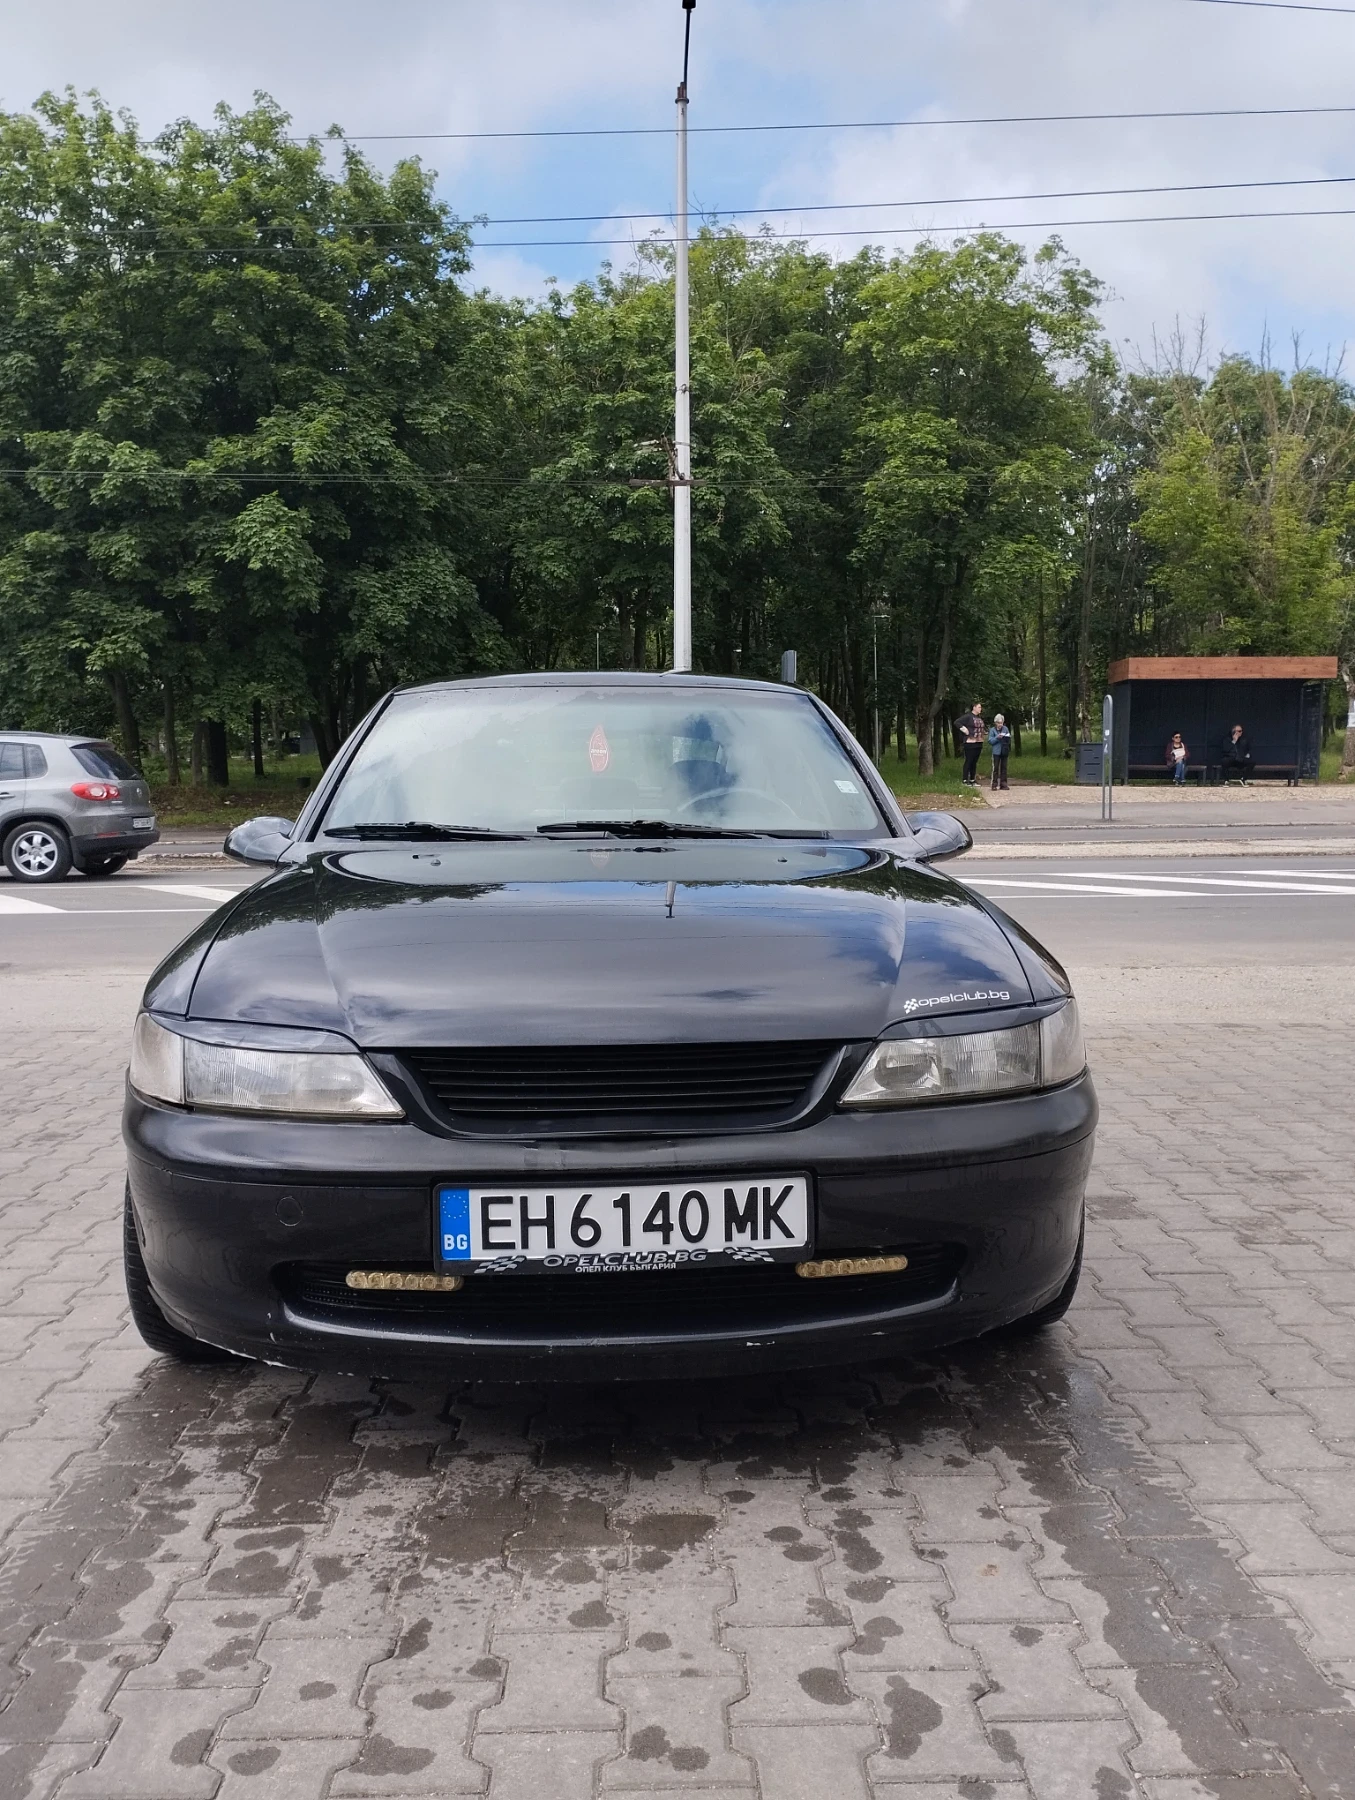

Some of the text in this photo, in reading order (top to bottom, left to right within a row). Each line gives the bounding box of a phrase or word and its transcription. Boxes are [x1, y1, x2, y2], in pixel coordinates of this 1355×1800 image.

[918, 990, 1010, 1007] opelclub.bg
[480, 1184, 795, 1250] EH 6140 MK
[444, 1234, 468, 1250] BG
[543, 1249, 709, 1267] OPELCLUB.BG
[575, 1262, 677, 1273] ОПЕЛ КЛУБ БЪЛГАРИЯ
